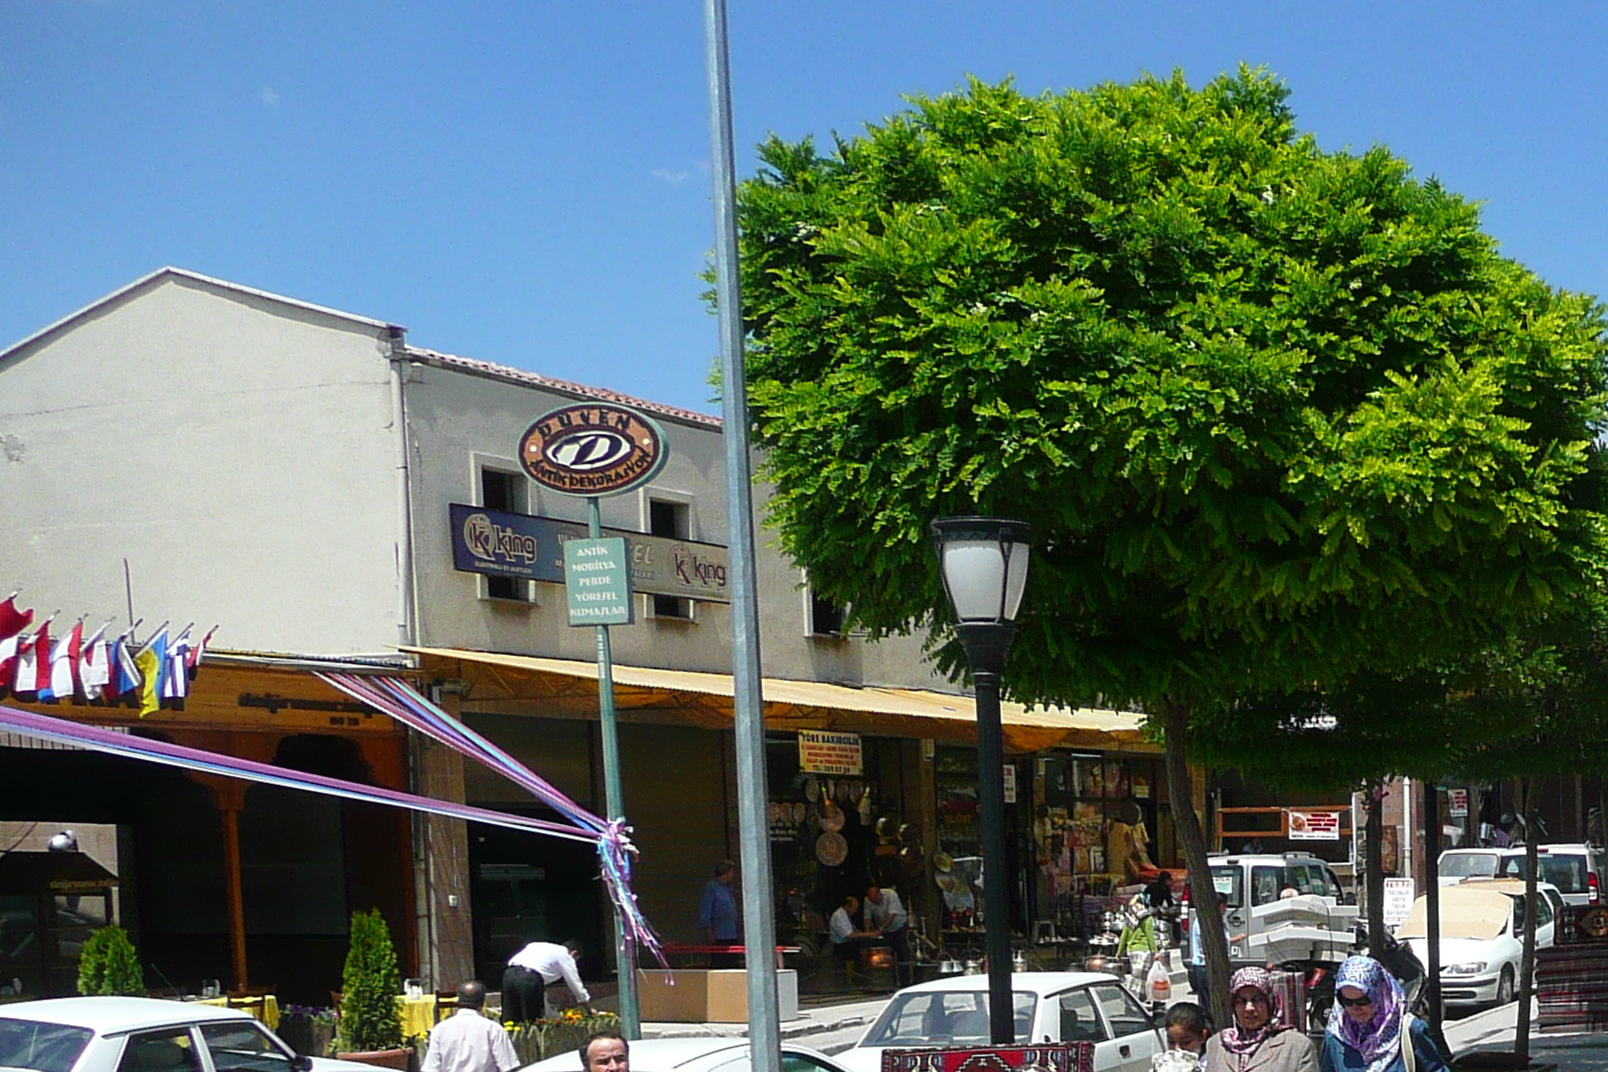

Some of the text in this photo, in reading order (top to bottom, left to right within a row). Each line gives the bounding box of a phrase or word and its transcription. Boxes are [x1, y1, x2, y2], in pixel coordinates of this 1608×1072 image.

[493, 524, 537, 564] king
[576, 544, 608, 557] ANTİK
[571, 559, 616, 572] MOBİLYA
[692, 553, 727, 590] king
[579, 576, 612, 587] PERDE
